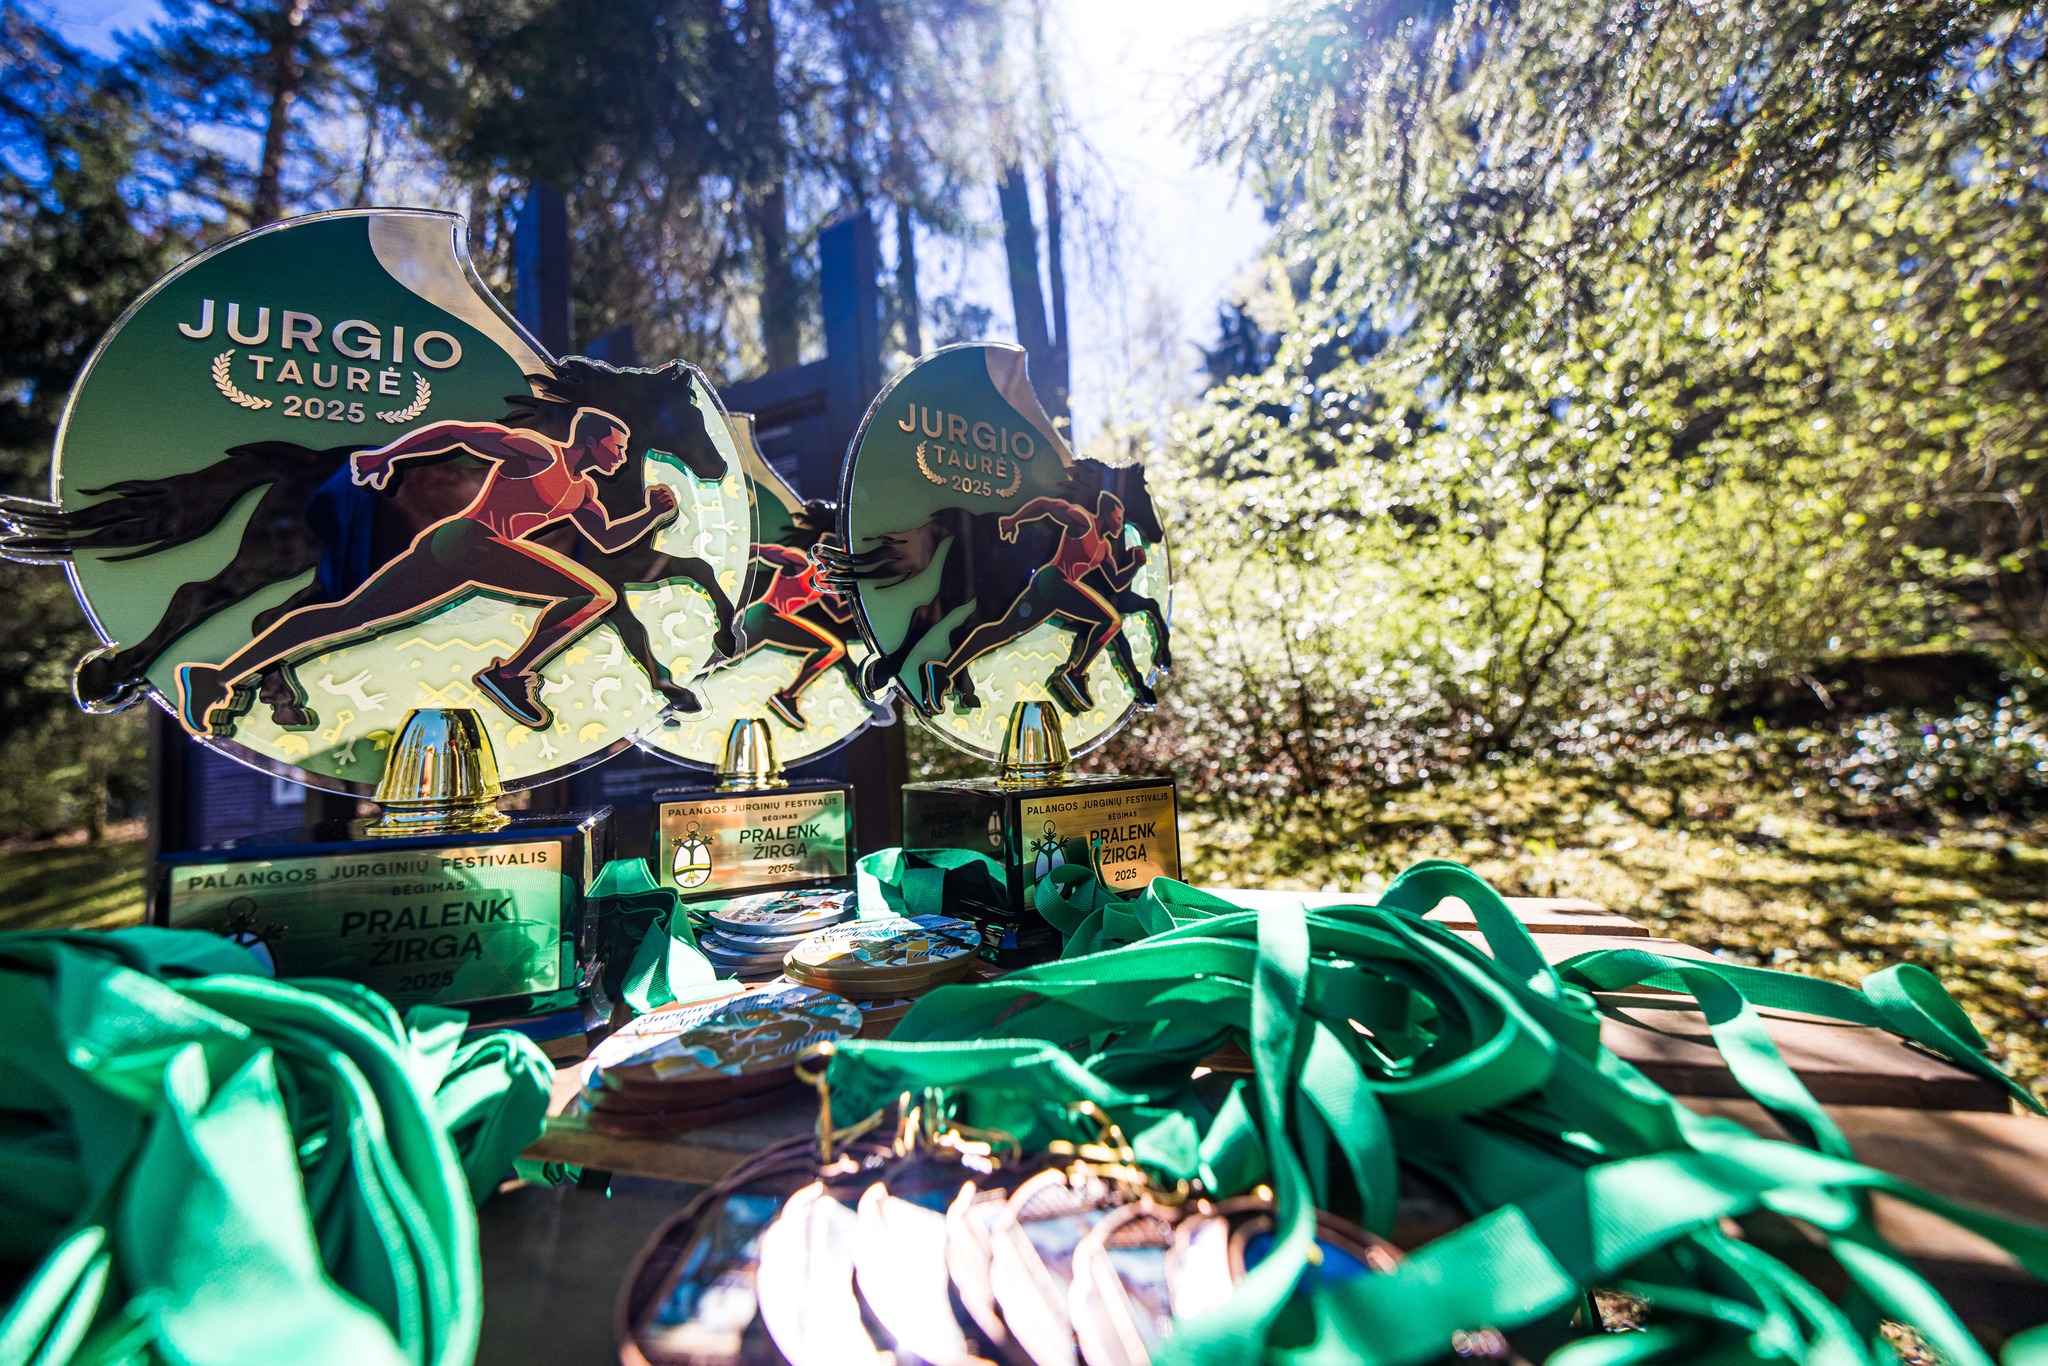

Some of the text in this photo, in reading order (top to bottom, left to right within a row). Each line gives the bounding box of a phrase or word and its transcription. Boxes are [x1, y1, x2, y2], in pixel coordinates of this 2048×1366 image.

[177, 298, 463, 370] JURGIO
[248, 354, 402, 396] TAURĖ
[283, 395, 366, 423] 2025
[898, 403, 1035, 461] JURGIO
[932, 444, 1008, 478] TAURĖ
[951, 475, 992, 497] 2025
[668, 797, 838, 817] PALANGOS JURGINIŲ FESTIVALIS
[1026, 792, 1169, 816] PALANGOS JURGINIŲ FESTIVALIS
[762, 813, 798, 822] BĖGIMAS
[1107, 810, 1138, 821] BĖGIMAS
[739, 823, 821, 844] PRALENK
[1090, 822, 1156, 845] PRALENK
[752, 842, 808, 860] ŽIRGĄ
[1102, 845, 1147, 865] ŽIRGĄ
[188, 850, 548, 890] PALANGOS JURGINIŲ FESTIVALIS
[767, 864, 795, 875] 2025
[1114, 868, 1138, 882] 2025
[391, 880, 465, 896] BĖGIMAS
[340, 897, 515, 938] PRALENK
[370, 931, 483, 967] ŽIRGĄ
[399, 970, 454, 992] 2025
